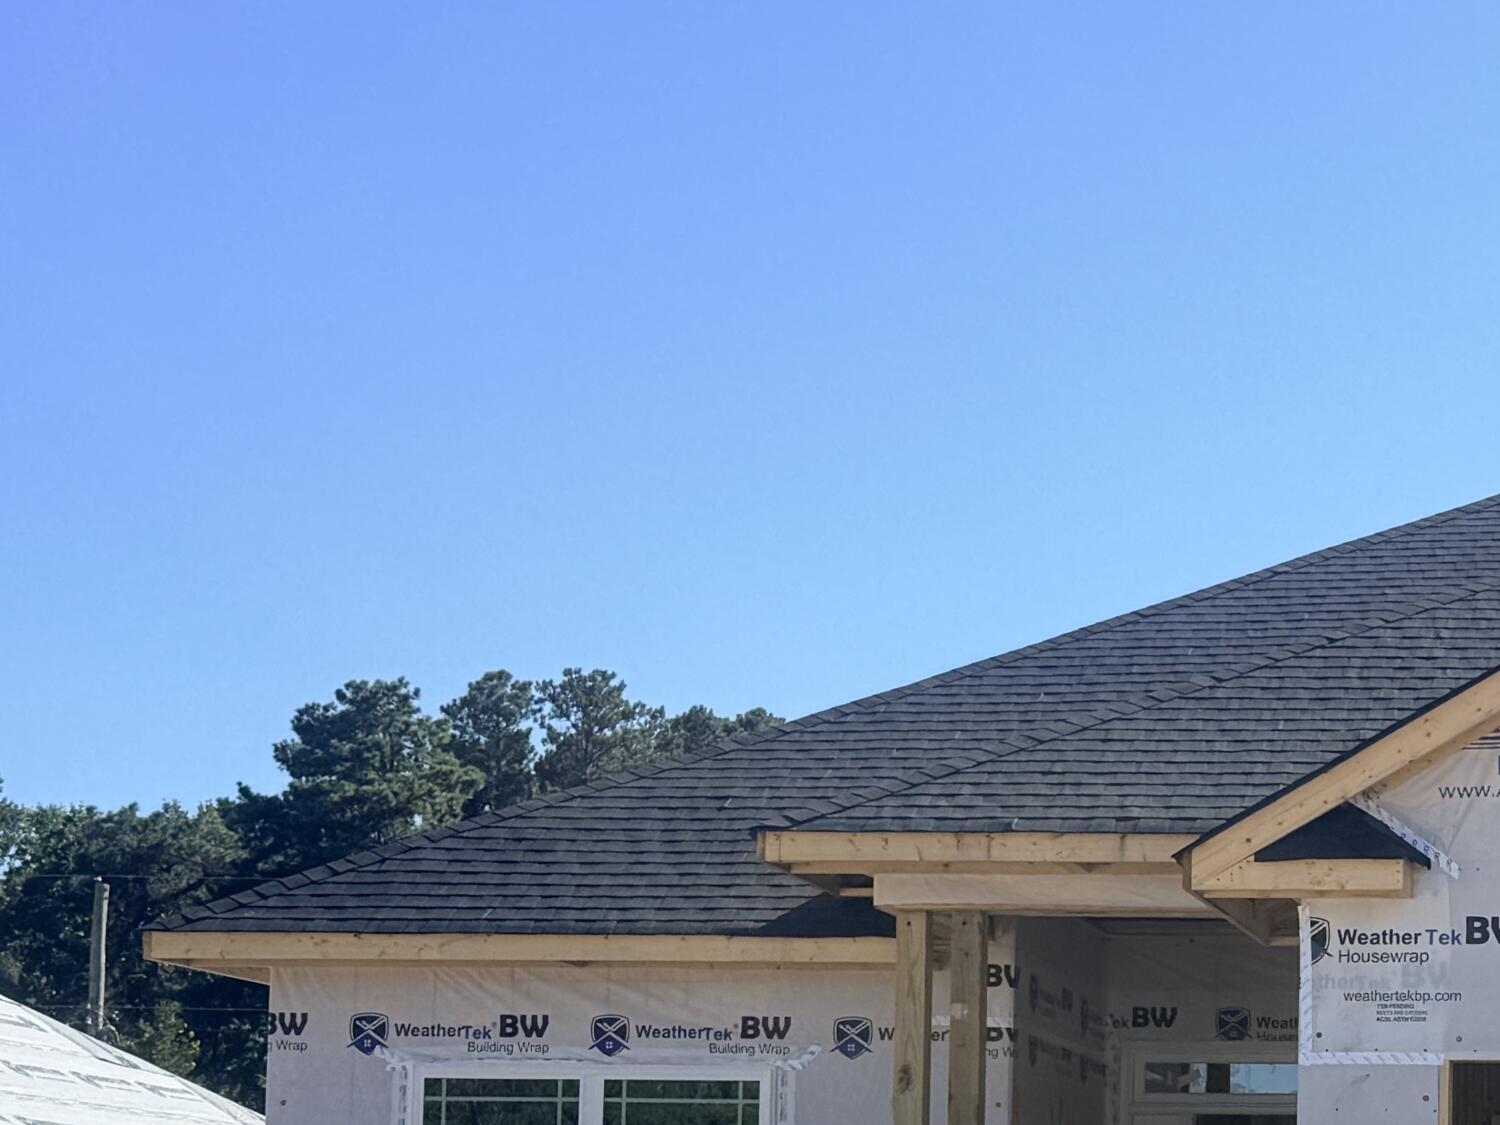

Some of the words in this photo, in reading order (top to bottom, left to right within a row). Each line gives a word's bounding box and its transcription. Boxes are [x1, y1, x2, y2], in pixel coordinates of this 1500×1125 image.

[1338, 950, 1430, 965] Housewrap
[1343, 990, 1462, 1004] weathertekbp.com
[1131, 1006, 1178, 1028] BW
[394, 1022, 492, 1040] WeatherTek
[499, 1014, 550, 1038] BW
[635, 1024, 733, 1042] WeatherTek
[740, 1016, 792, 1040] BW
[276, 1040, 308, 1052] Wrap
[467, 1041, 515, 1055] Building
[517, 1042, 550, 1054] Wrap
[708, 1043, 755, 1056] Building
[758, 1044, 791, 1056] Wrap
